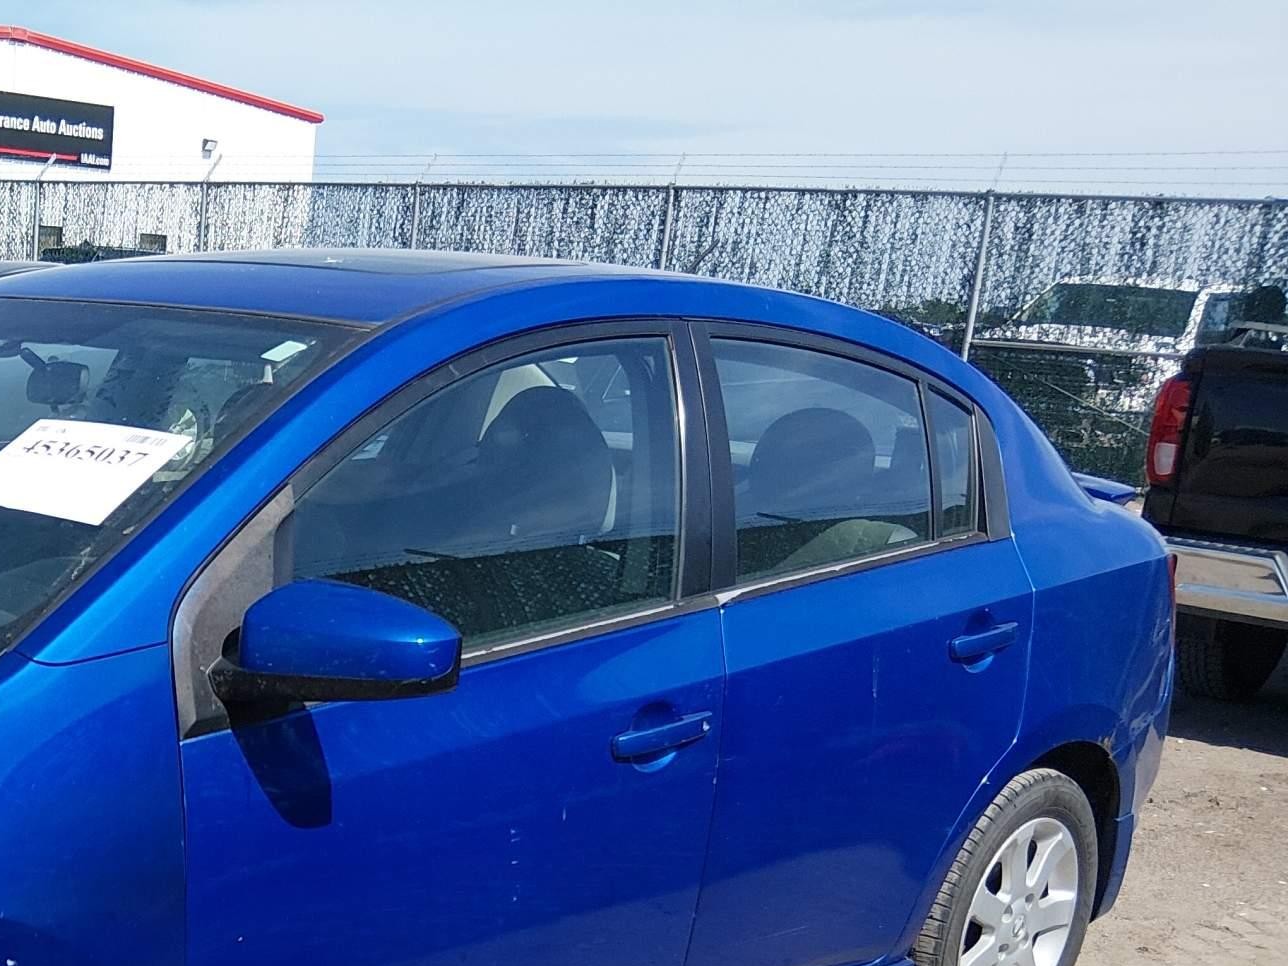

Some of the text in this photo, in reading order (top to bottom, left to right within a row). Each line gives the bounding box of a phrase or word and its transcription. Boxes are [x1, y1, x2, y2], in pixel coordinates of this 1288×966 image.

[32, 116, 57, 134] Auto
[58, 119, 104, 141] Auctions
[23, 439, 149, 467] 45365037
